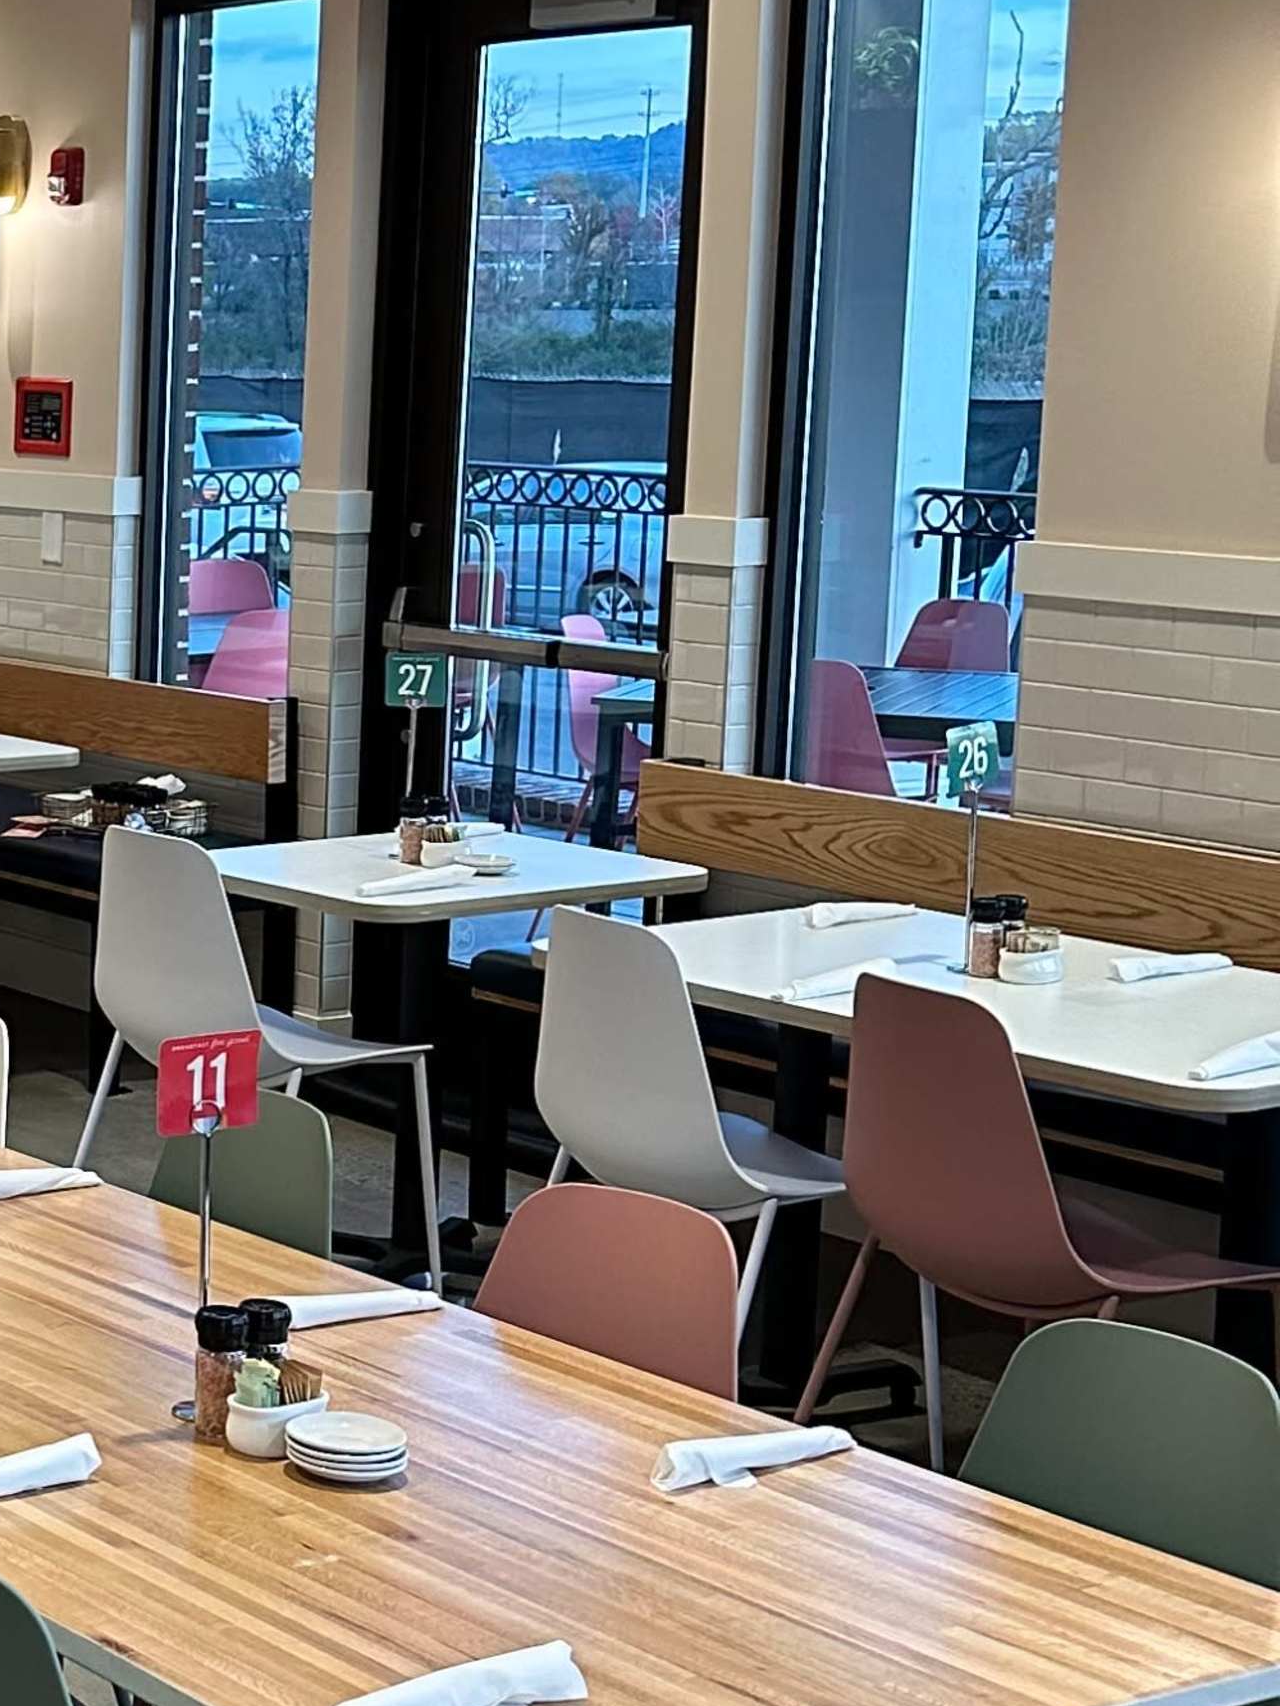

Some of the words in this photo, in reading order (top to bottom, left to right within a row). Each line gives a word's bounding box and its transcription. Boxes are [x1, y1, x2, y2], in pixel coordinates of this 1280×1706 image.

[398, 663, 433, 695] 27
[958, 736, 989, 779] 26
[186, 1052, 228, 1112] 11
